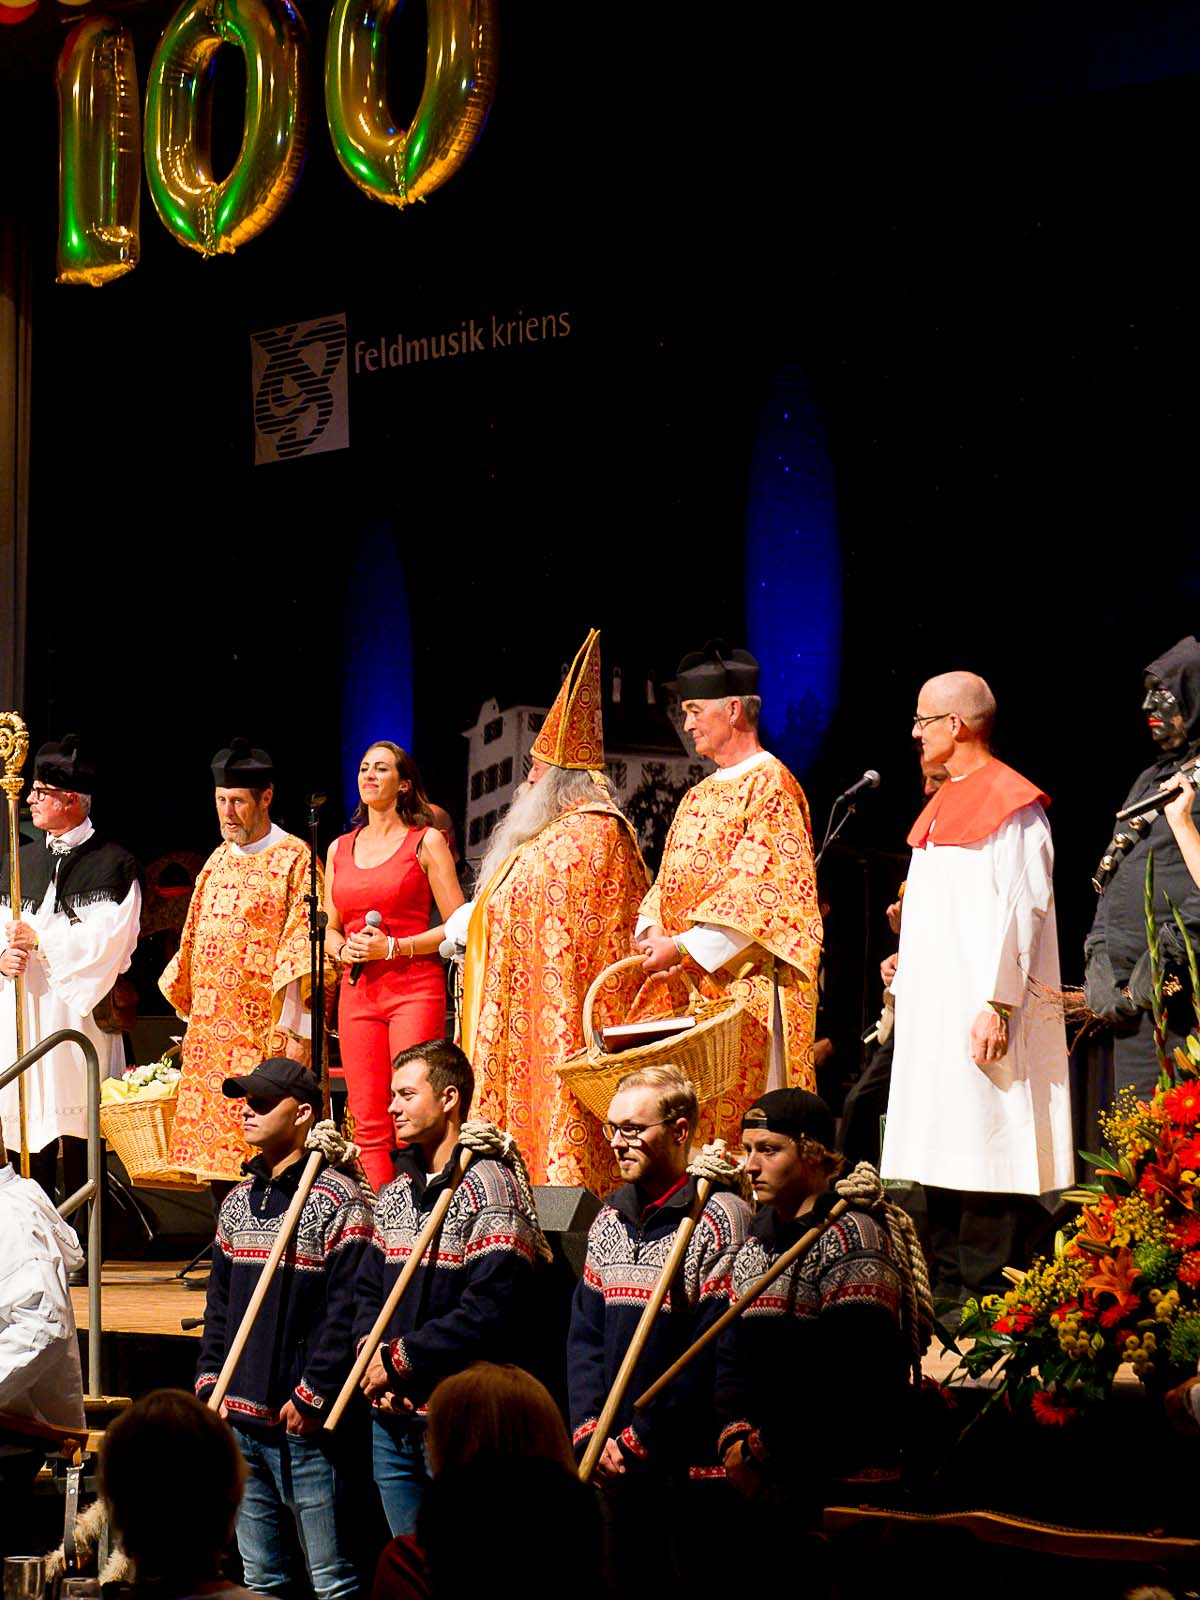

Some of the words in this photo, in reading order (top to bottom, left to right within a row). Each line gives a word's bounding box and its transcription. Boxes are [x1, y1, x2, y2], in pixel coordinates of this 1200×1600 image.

[56, 0, 497, 286] 100
[353, 319, 485, 375] feldmusik
[491, 308, 572, 349] kriens
